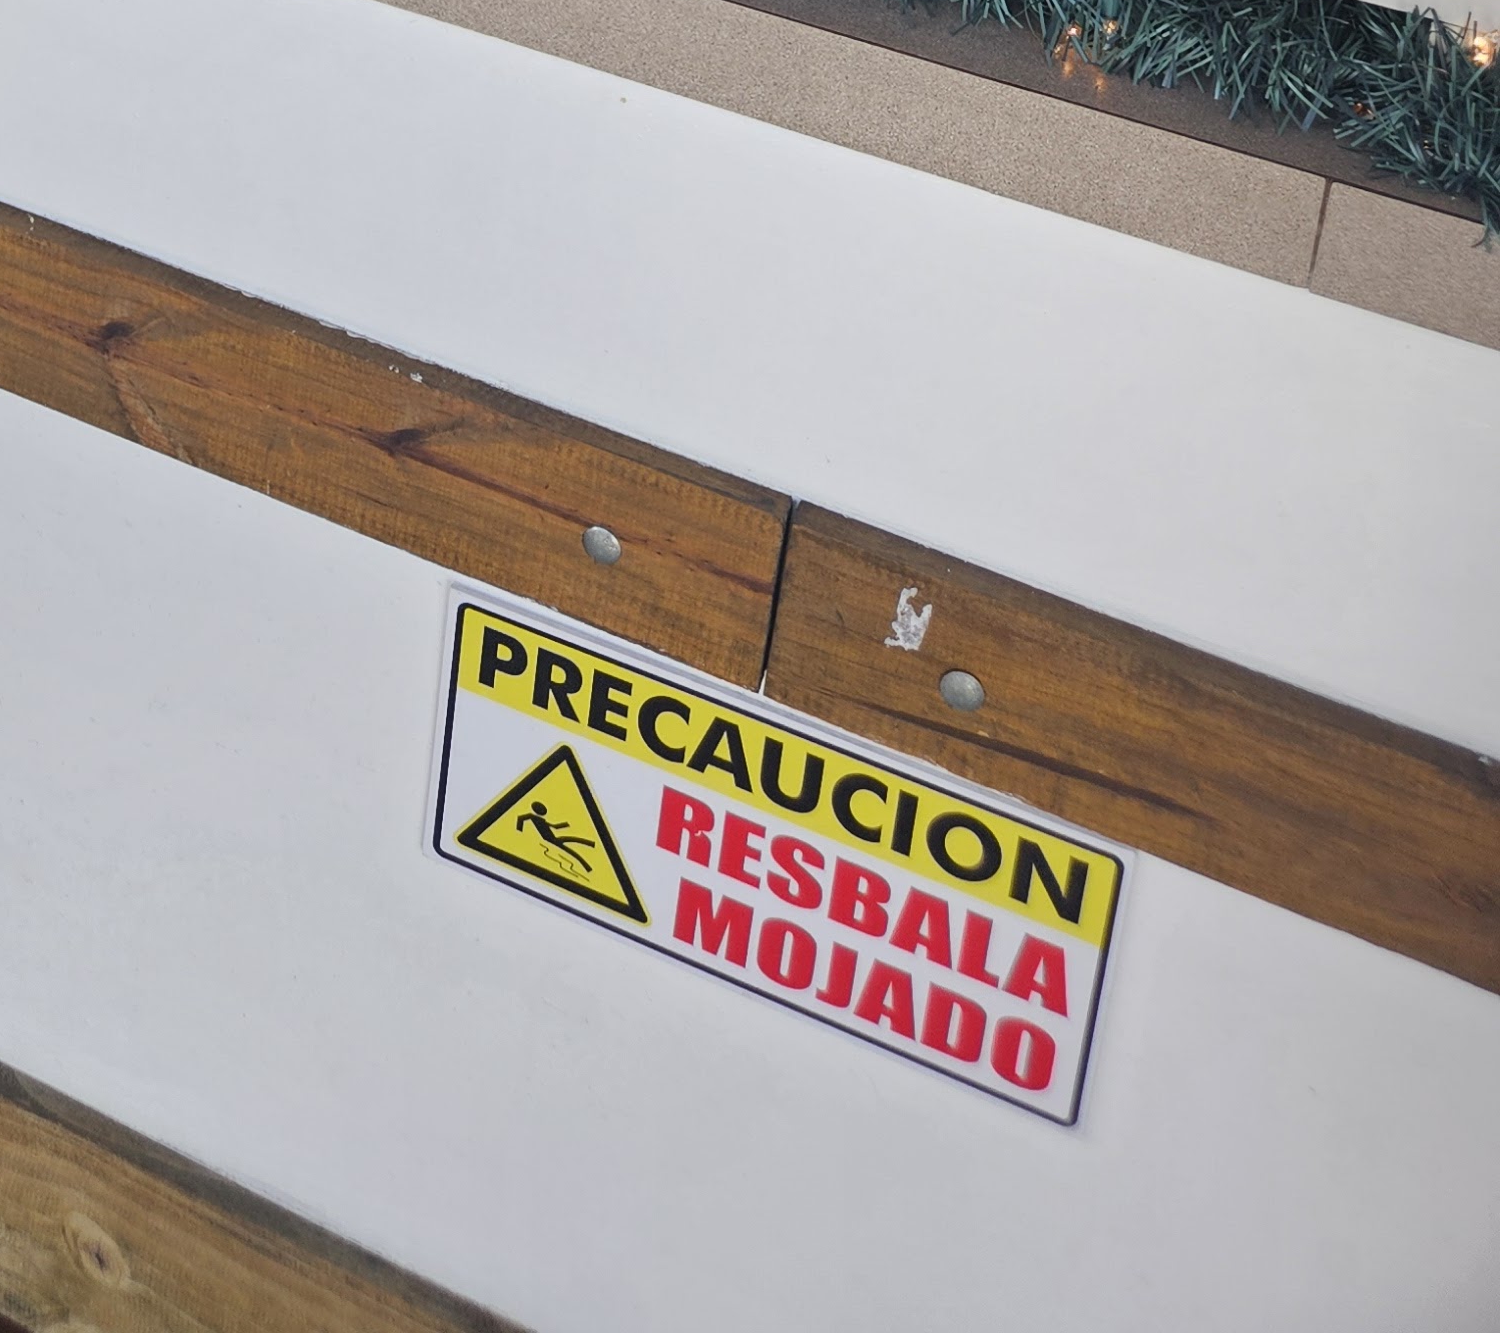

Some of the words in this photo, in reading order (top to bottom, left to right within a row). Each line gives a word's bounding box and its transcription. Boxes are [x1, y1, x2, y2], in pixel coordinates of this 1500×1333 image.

[477, 624, 1091, 926] PRECAUCION
[656, 785, 1070, 1018] RESBALA
[674, 878, 1057, 1093] MOJADO
